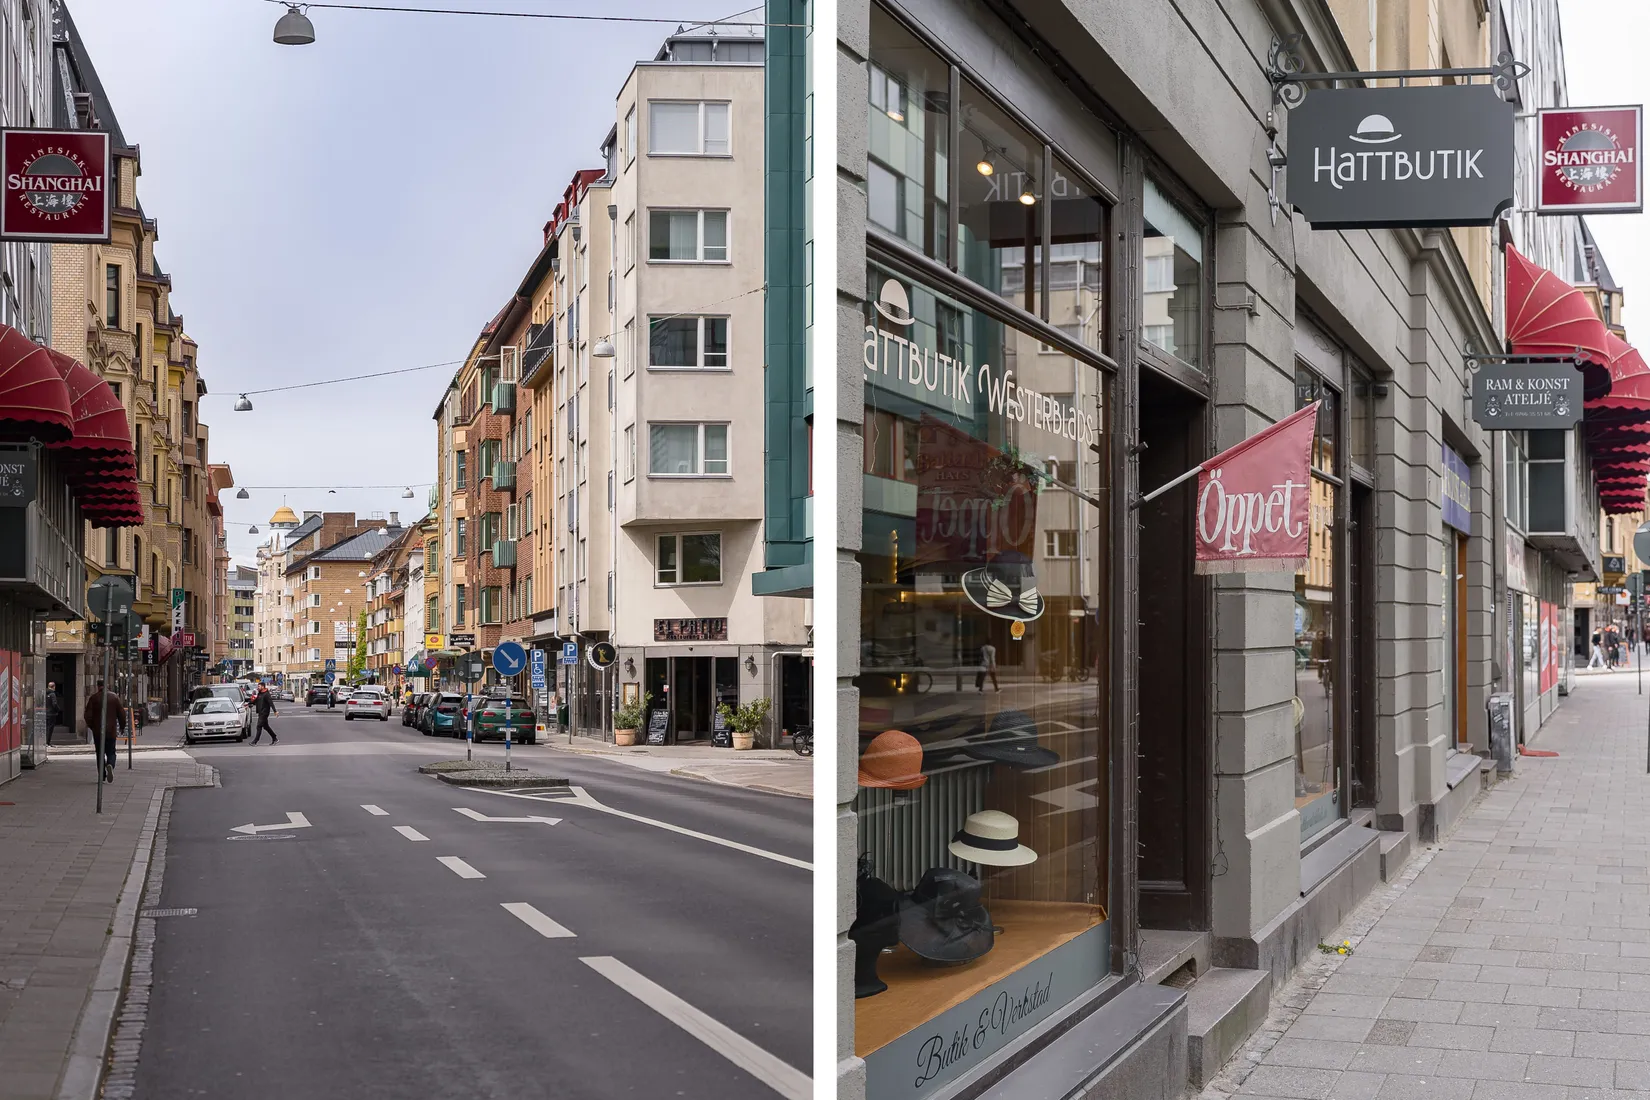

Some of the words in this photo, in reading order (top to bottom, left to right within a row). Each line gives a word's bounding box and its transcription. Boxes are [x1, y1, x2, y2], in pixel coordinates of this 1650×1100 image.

[1558, 122, 1618, 145] KINESISK
[23, 146, 87, 169] KINESISK
[1544, 147, 1634, 167] SHANGHAI
[8, 174, 102, 192] SHANGHAI
[1554, 166, 1622, 193] RESTAURANT
[18, 194, 89, 221] RESTAURANT
[1486, 378, 1512, 390] RAM
[1515, 378, 1525, 390] &
[1527, 377, 1570, 390] KONST
[1504, 390, 1552, 405] ATELJÉ
[1198, 468, 1307, 556] Öppet
[175, 591, 183, 646] PIZZERIA
[534, 651, 541, 662] P
[567, 644, 575, 656] P
[915, 1023, 970, 1088] Butik
[973, 1007, 991, 1049] &
[991, 971, 1053, 1036] Verkstad
